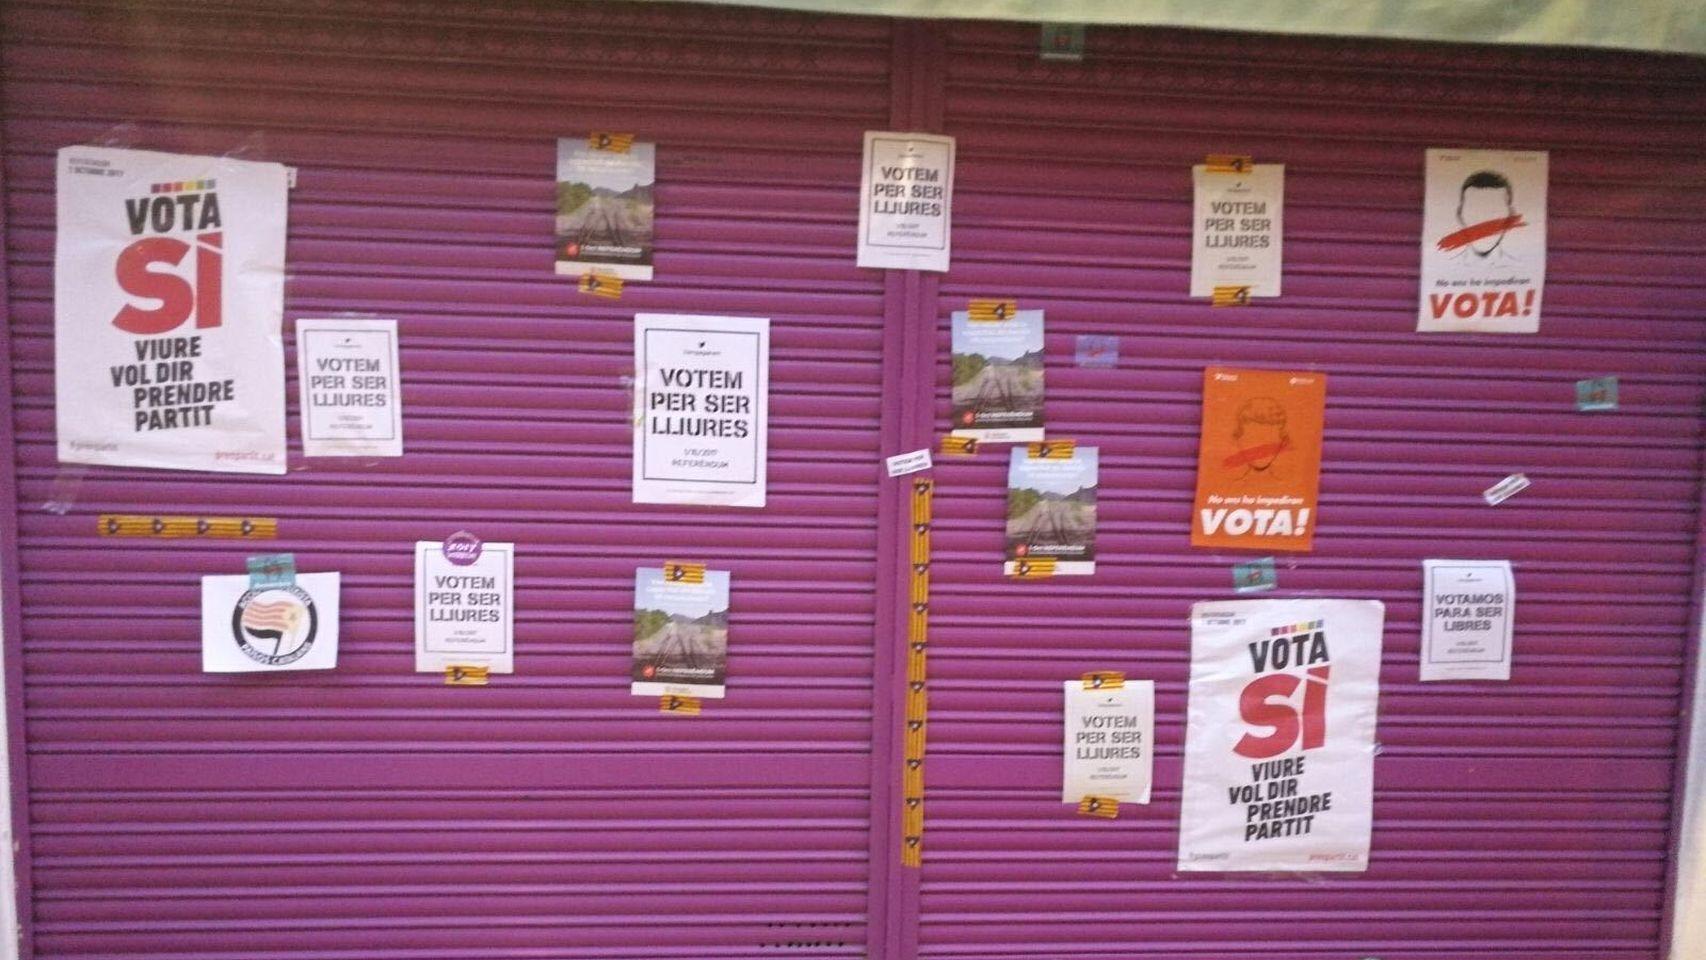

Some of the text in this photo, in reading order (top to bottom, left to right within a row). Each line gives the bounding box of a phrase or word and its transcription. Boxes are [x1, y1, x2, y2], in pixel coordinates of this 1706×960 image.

[881, 166, 939, 182] VOTEM
[874, 183, 942, 199] PER SER
[126, 192, 222, 235] VOTA
[874, 200, 941, 217] LLIURES
[1211, 201, 1266, 215] VOTEM
[1205, 218, 1271, 231] PER SER
[1205, 235, 1270, 248] LLIURES
[1429, 289, 1536, 320] VOTA!
[135, 336, 203, 361] VIURE
[316, 358, 380, 372] VOTEM
[111, 361, 194, 387] VOL DIR
[311, 375, 386, 389] PER SER
[660, 368, 743, 389] VOTEM
[134, 379, 235, 408] PRENDRE
[313, 393, 386, 407] LLIURES
[651, 392, 750, 414] PER SER
[135, 405, 215, 432] PARTIT
[651, 416, 749, 439] LLIURES
[1200, 508, 1310, 536] VOTA!
[435, 575, 495, 589] VOTEM
[429, 592, 501, 606] PER SER
[1435, 594, 1503, 605] VOTAMOS
[430, 608, 500, 622] LLIURES
[1434, 607, 1503, 618] PARA SER
[1248, 631, 1330, 674] VOTA
[1080, 715, 1137, 729] VOTEM
[1076, 731, 1142, 744] PER SER
[1076, 747, 1141, 760] LLIURES
[1251, 756, 1305, 782] VIURE
[1228, 779, 1298, 805] VOL DIR
[1246, 792, 1332, 823] PRENDRE
[1244, 815, 1314, 841] PARTIT
